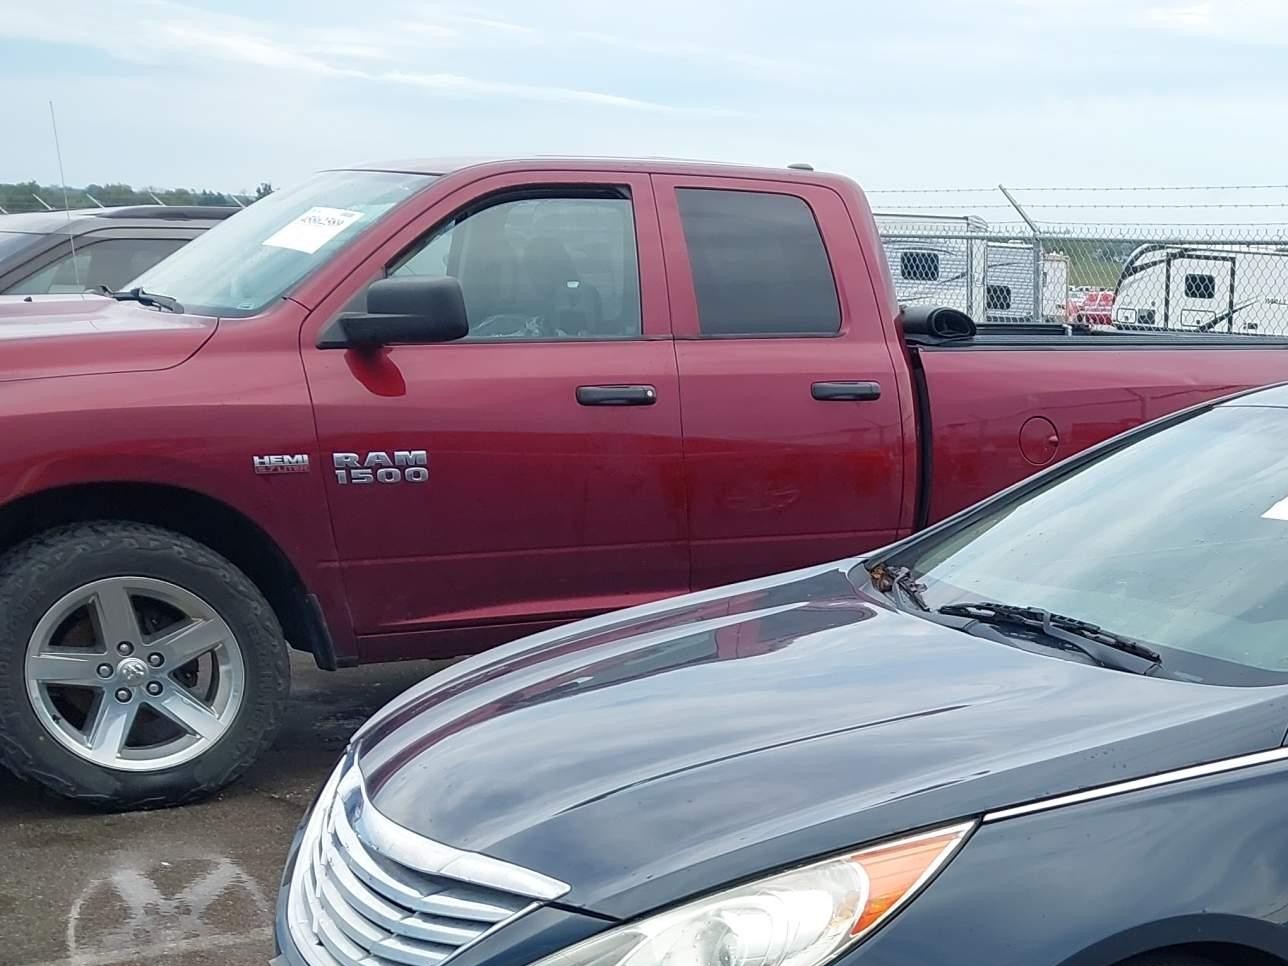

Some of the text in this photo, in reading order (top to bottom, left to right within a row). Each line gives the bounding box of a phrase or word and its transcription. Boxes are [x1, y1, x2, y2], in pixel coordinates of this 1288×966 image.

[253, 454, 309, 466] HEMI
[333, 450, 428, 469] RAM
[335, 467, 429, 485] 1500
